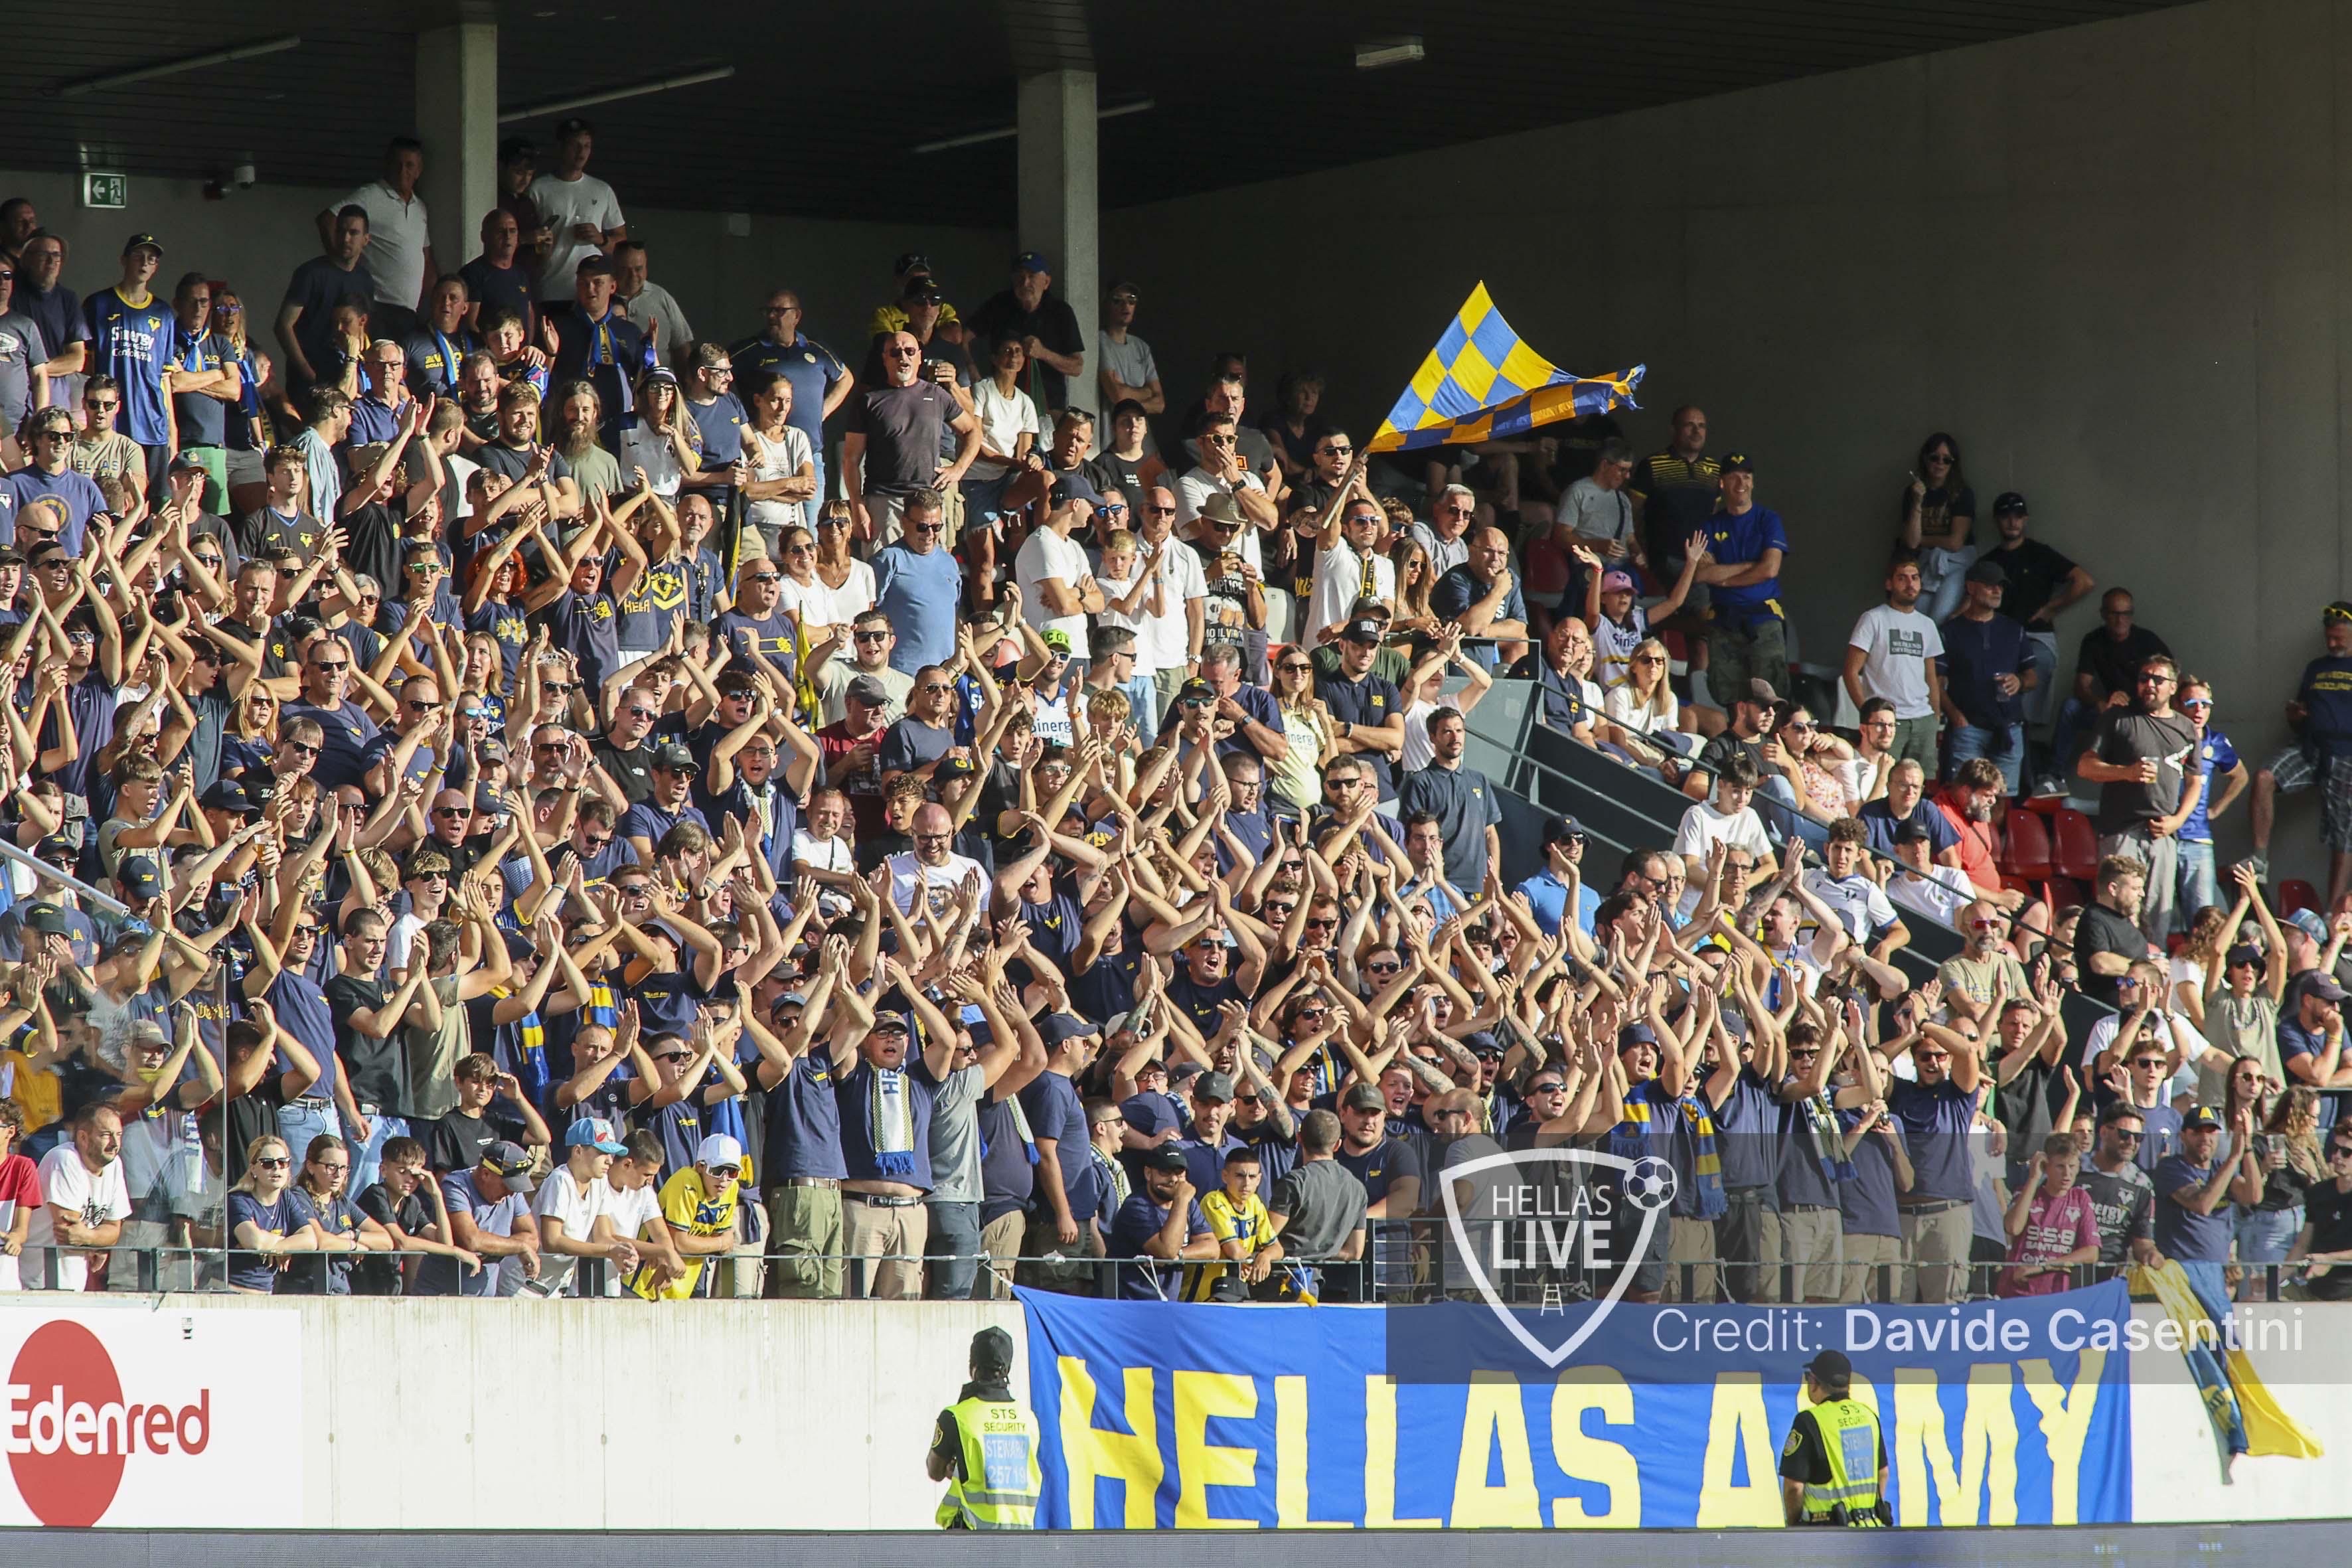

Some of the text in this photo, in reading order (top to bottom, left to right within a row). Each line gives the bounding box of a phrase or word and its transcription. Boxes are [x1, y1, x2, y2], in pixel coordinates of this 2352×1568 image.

[111, 326, 155, 351] Sinergy
[1031, 718, 1071, 734] Sinerg
[6, 1384, 210, 1455] Edenred
[990, 1409, 1017, 1420] STS
[984, 1423, 1026, 1432] SECURITY
[1058, 1356, 1641, 1529] HELLAS
